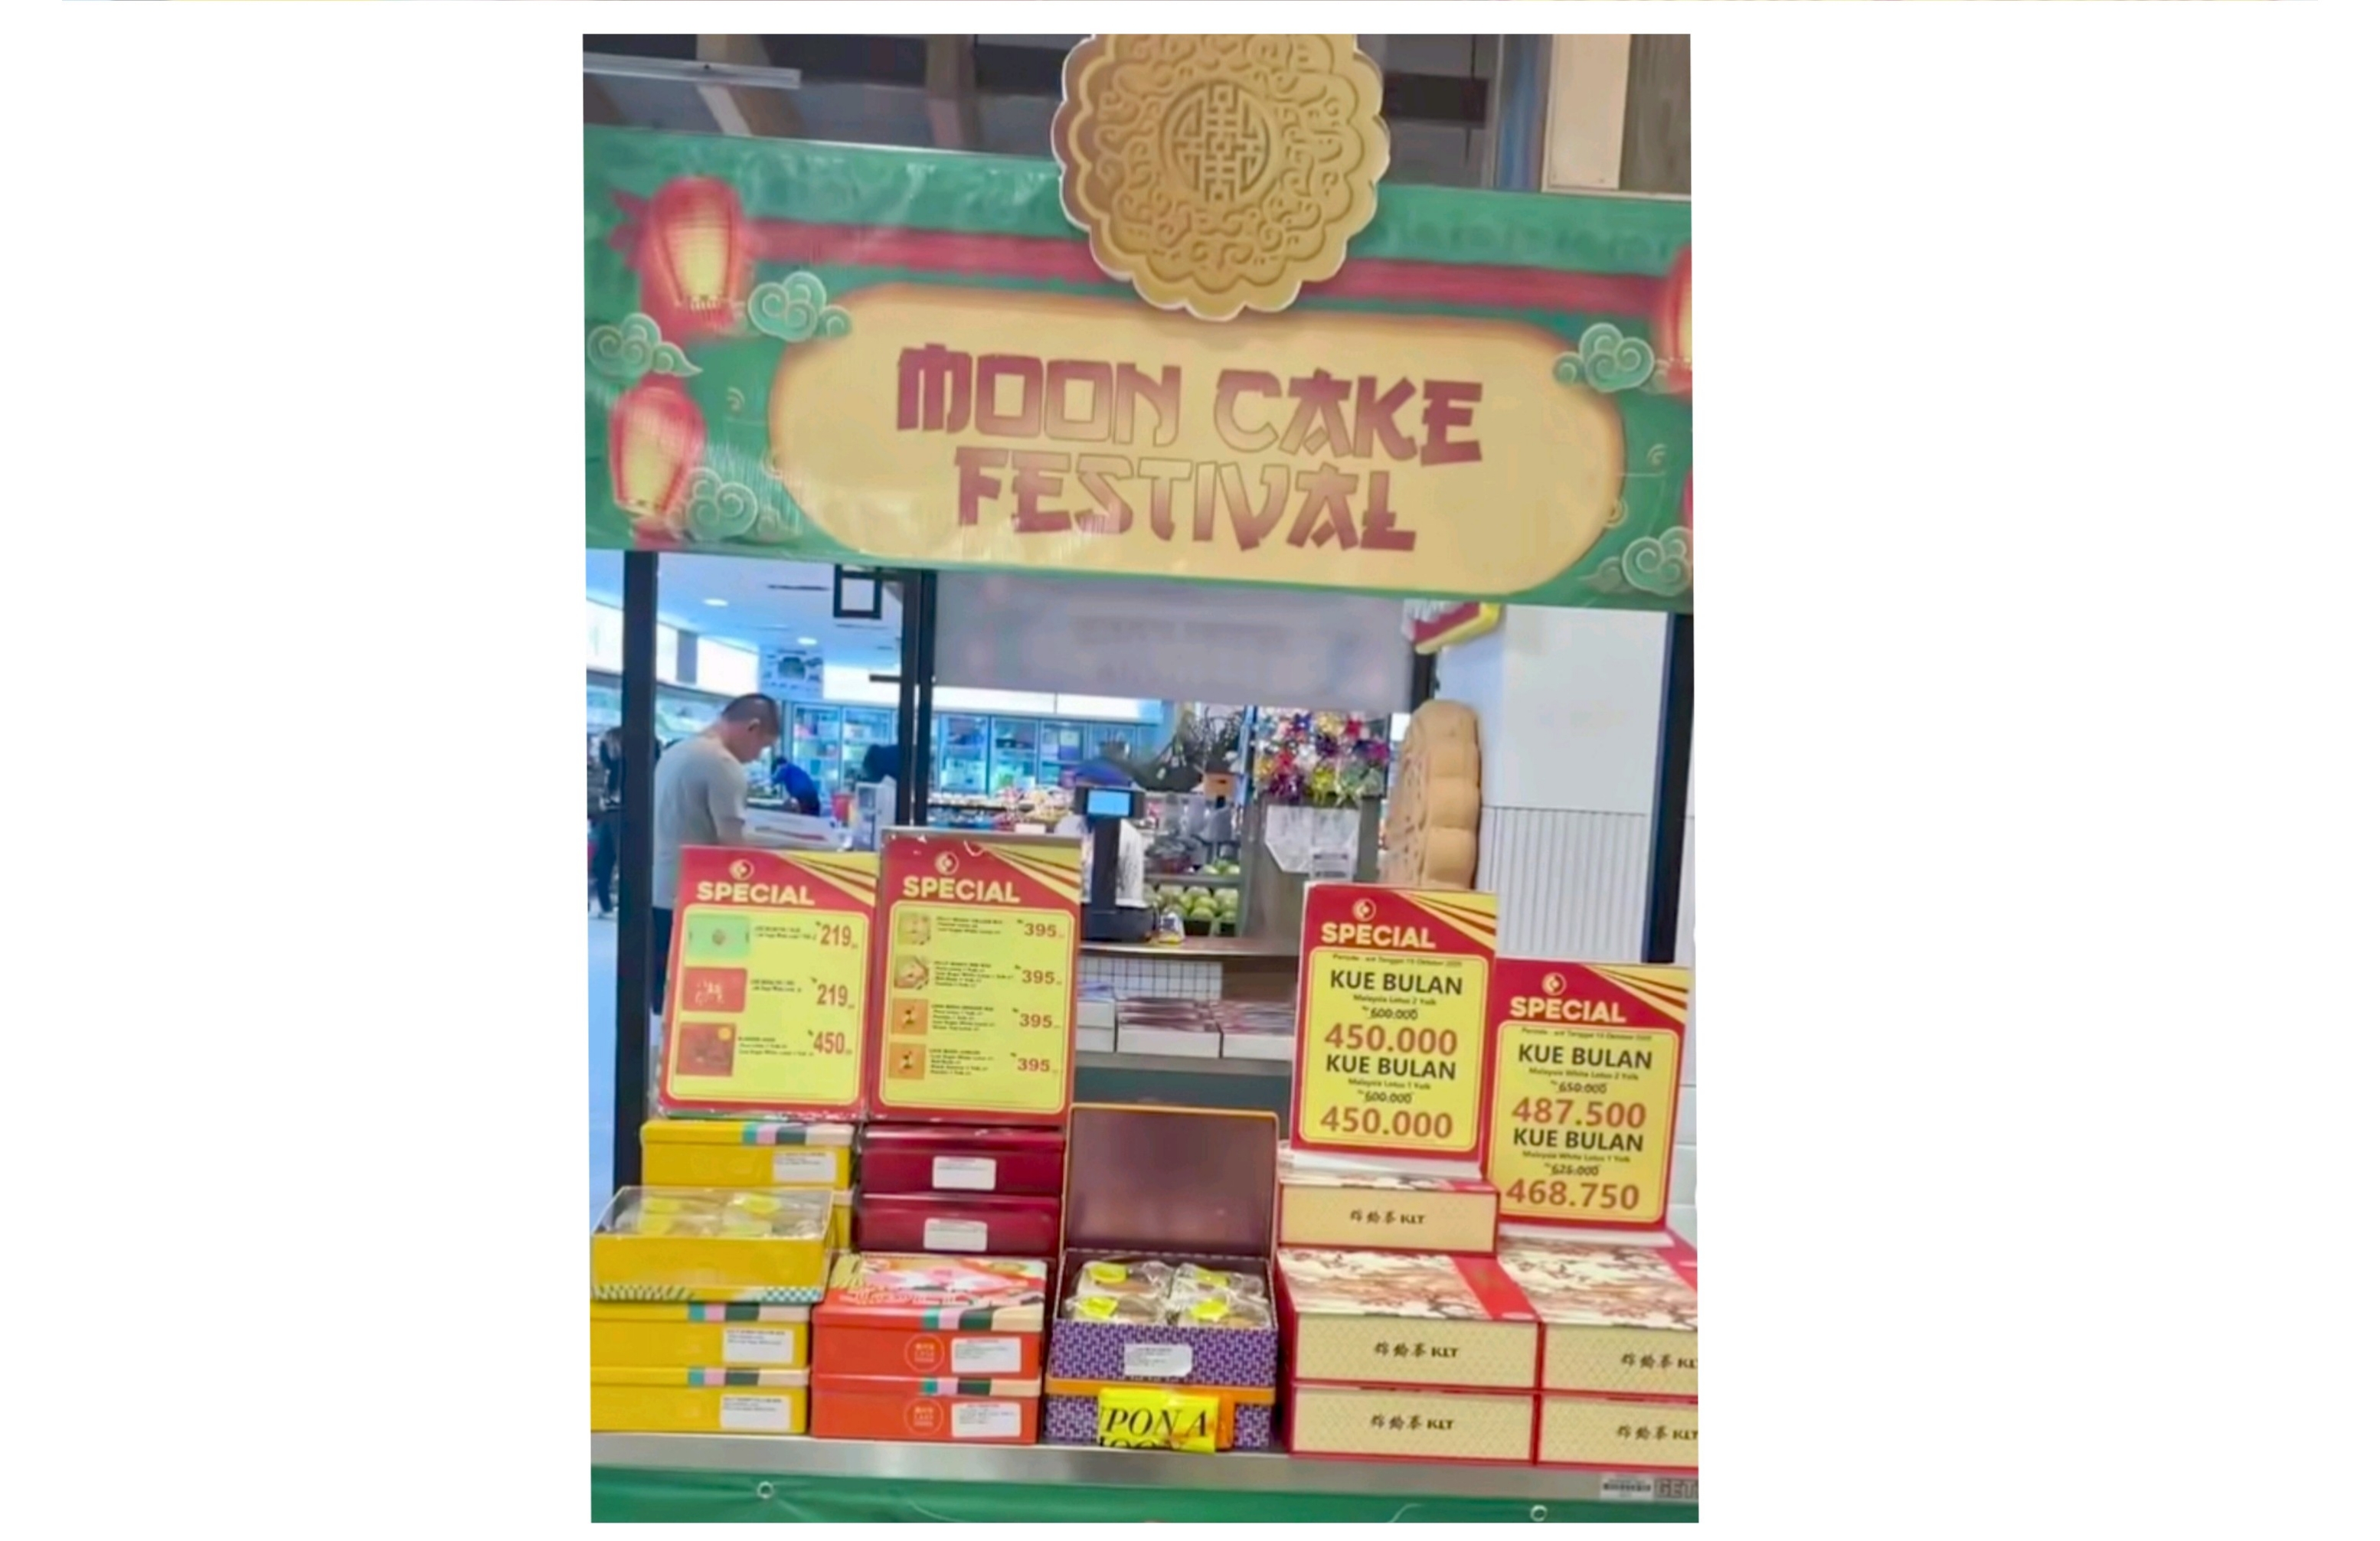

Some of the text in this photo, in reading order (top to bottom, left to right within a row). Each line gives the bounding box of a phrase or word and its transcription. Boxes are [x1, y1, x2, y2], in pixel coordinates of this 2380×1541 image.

[897, 344, 1483, 467] MOON CAKE
[954, 446, 1417, 553] FESTIVAL
[696, 881, 815, 906] SPECIAL
[903, 876, 1021, 903] SPECIAL
[820, 923, 852, 947] 219
[1024, 922, 1058, 938] 395
[1321, 922, 1437, 949] SPECIAL
[1022, 969, 1055, 985] 395
[1331, 970, 1463, 995] KUE BULAN
[816, 983, 848, 1007] 219
[1019, 1013, 1053, 1029] 395
[1370, 1007, 1418, 1020] 600.000
[1510, 997, 1627, 1023] SPECIAL
[813, 1031, 845, 1054] 450
[1325, 1024, 1458, 1056] 450.000
[1017, 1057, 1051, 1073] 395
[1326, 1055, 1456, 1080] KUE BULAN
[1519, 1044, 1653, 1069] KUE BULAN
[1590, 1071, 1613, 1079] Lotus
[1365, 1090, 1413, 1104] 600.000
[1558, 1082, 1607, 1095] 650.000
[1320, 1106, 1453, 1138] 450.000
[1512, 1097, 1647, 1129] 487.500
[1514, 1128, 1644, 1152] KUE BULAN
[1506, 1179, 1640, 1211] 468.750
[1678, 1358, 1698, 1369] KL
[1101, 1407, 1208, 1437] PON A
